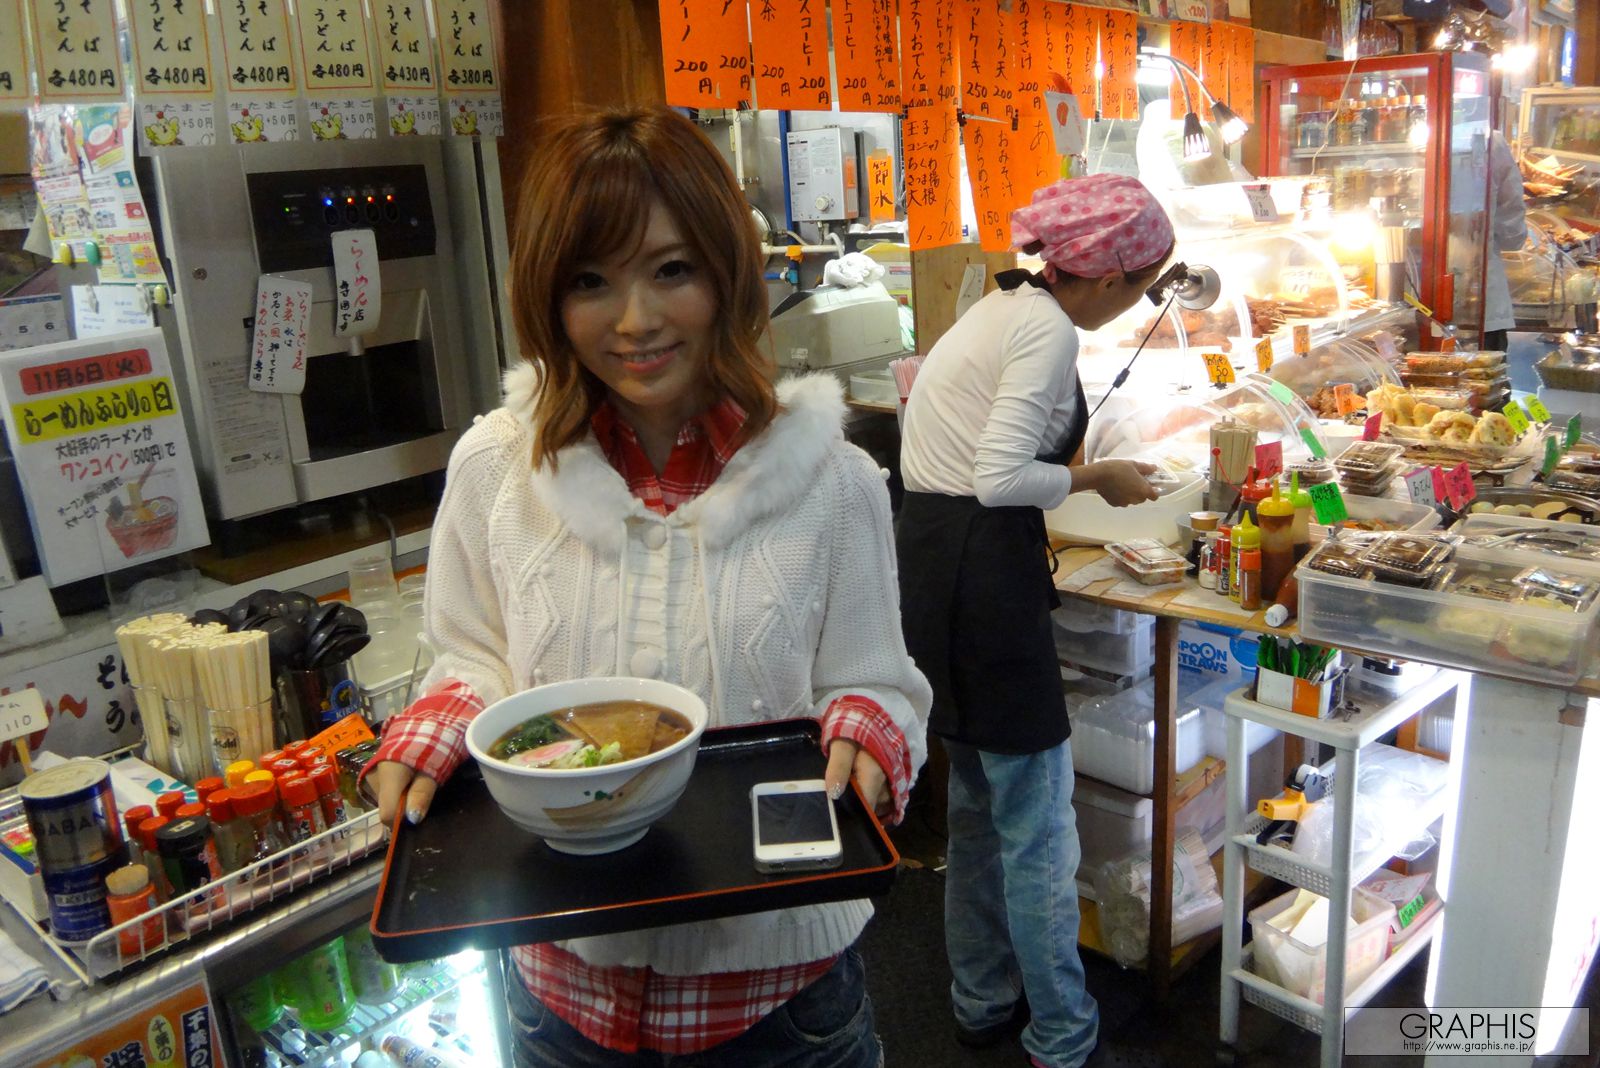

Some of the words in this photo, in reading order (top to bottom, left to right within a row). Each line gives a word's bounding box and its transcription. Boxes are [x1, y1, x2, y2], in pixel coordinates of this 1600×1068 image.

[236, 0, 255, 52] うどん
[258, 0, 277, 52] そば
[314, 8, 333, 52] うどん
[336, 8, 356, 51] そば
[386, 4, 402, 53] うどん
[403, 6, 420, 53] そば
[450, 10, 466, 57] うどん
[467, 11, 483, 57] そば
[311, 63, 365, 79] 各480円
[674, 59, 708, 73] 200
[719, 55, 748, 70] 200
[761, 65, 785, 78] 200
[48, 68, 115, 88] 各480円
[145, 67, 206, 86] 各480円
[232, 65, 290, 84] 各480円
[385, 65, 431, 84] 各430円
[448, 68, 493, 85] 各380円
[740, 75, 750, 91] 円
[799, 76, 826, 89] 200
[843, 77, 867, 89] 200
[699, 77, 712, 95] 円
[781, 82, 791, 97] 円
[966, 81, 988, 99] 250
[993, 85, 1013, 100] 200
[1018, 82, 1039, 93] 200
[818, 91, 829, 105] 円
[862, 92, 872, 105] 円
[907, 119, 931, 138] 玉子
[906, 188, 937, 209] 大根
[18, 325, 28, 334] 5
[45, 322, 54, 331] 6
